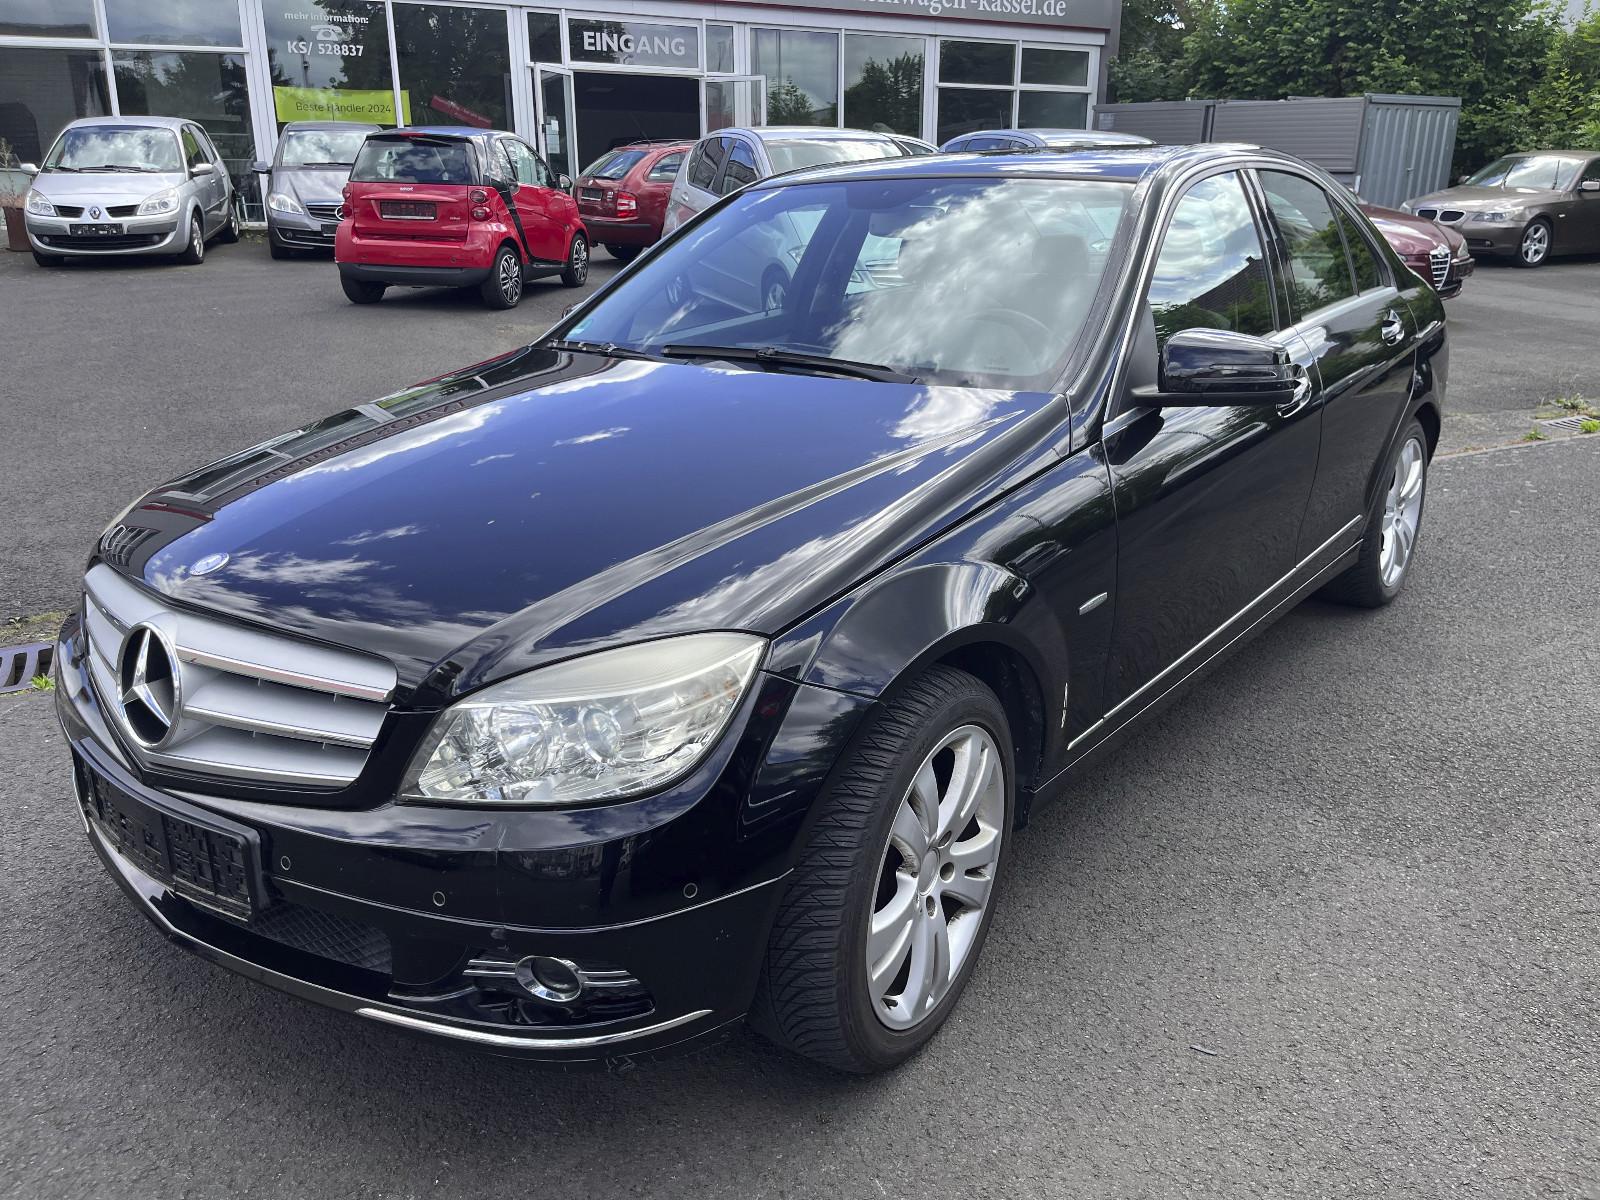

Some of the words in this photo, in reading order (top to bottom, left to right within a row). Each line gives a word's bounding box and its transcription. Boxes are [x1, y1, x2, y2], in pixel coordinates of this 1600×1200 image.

[284, 11, 309, 21] mehr
[287, 40, 313, 56] KS/
[318, 43, 364, 57] 528837
[583, 31, 685, 56] EINGANG
[296, 101, 325, 112] Beste
[367, 104, 392, 113] 2024
